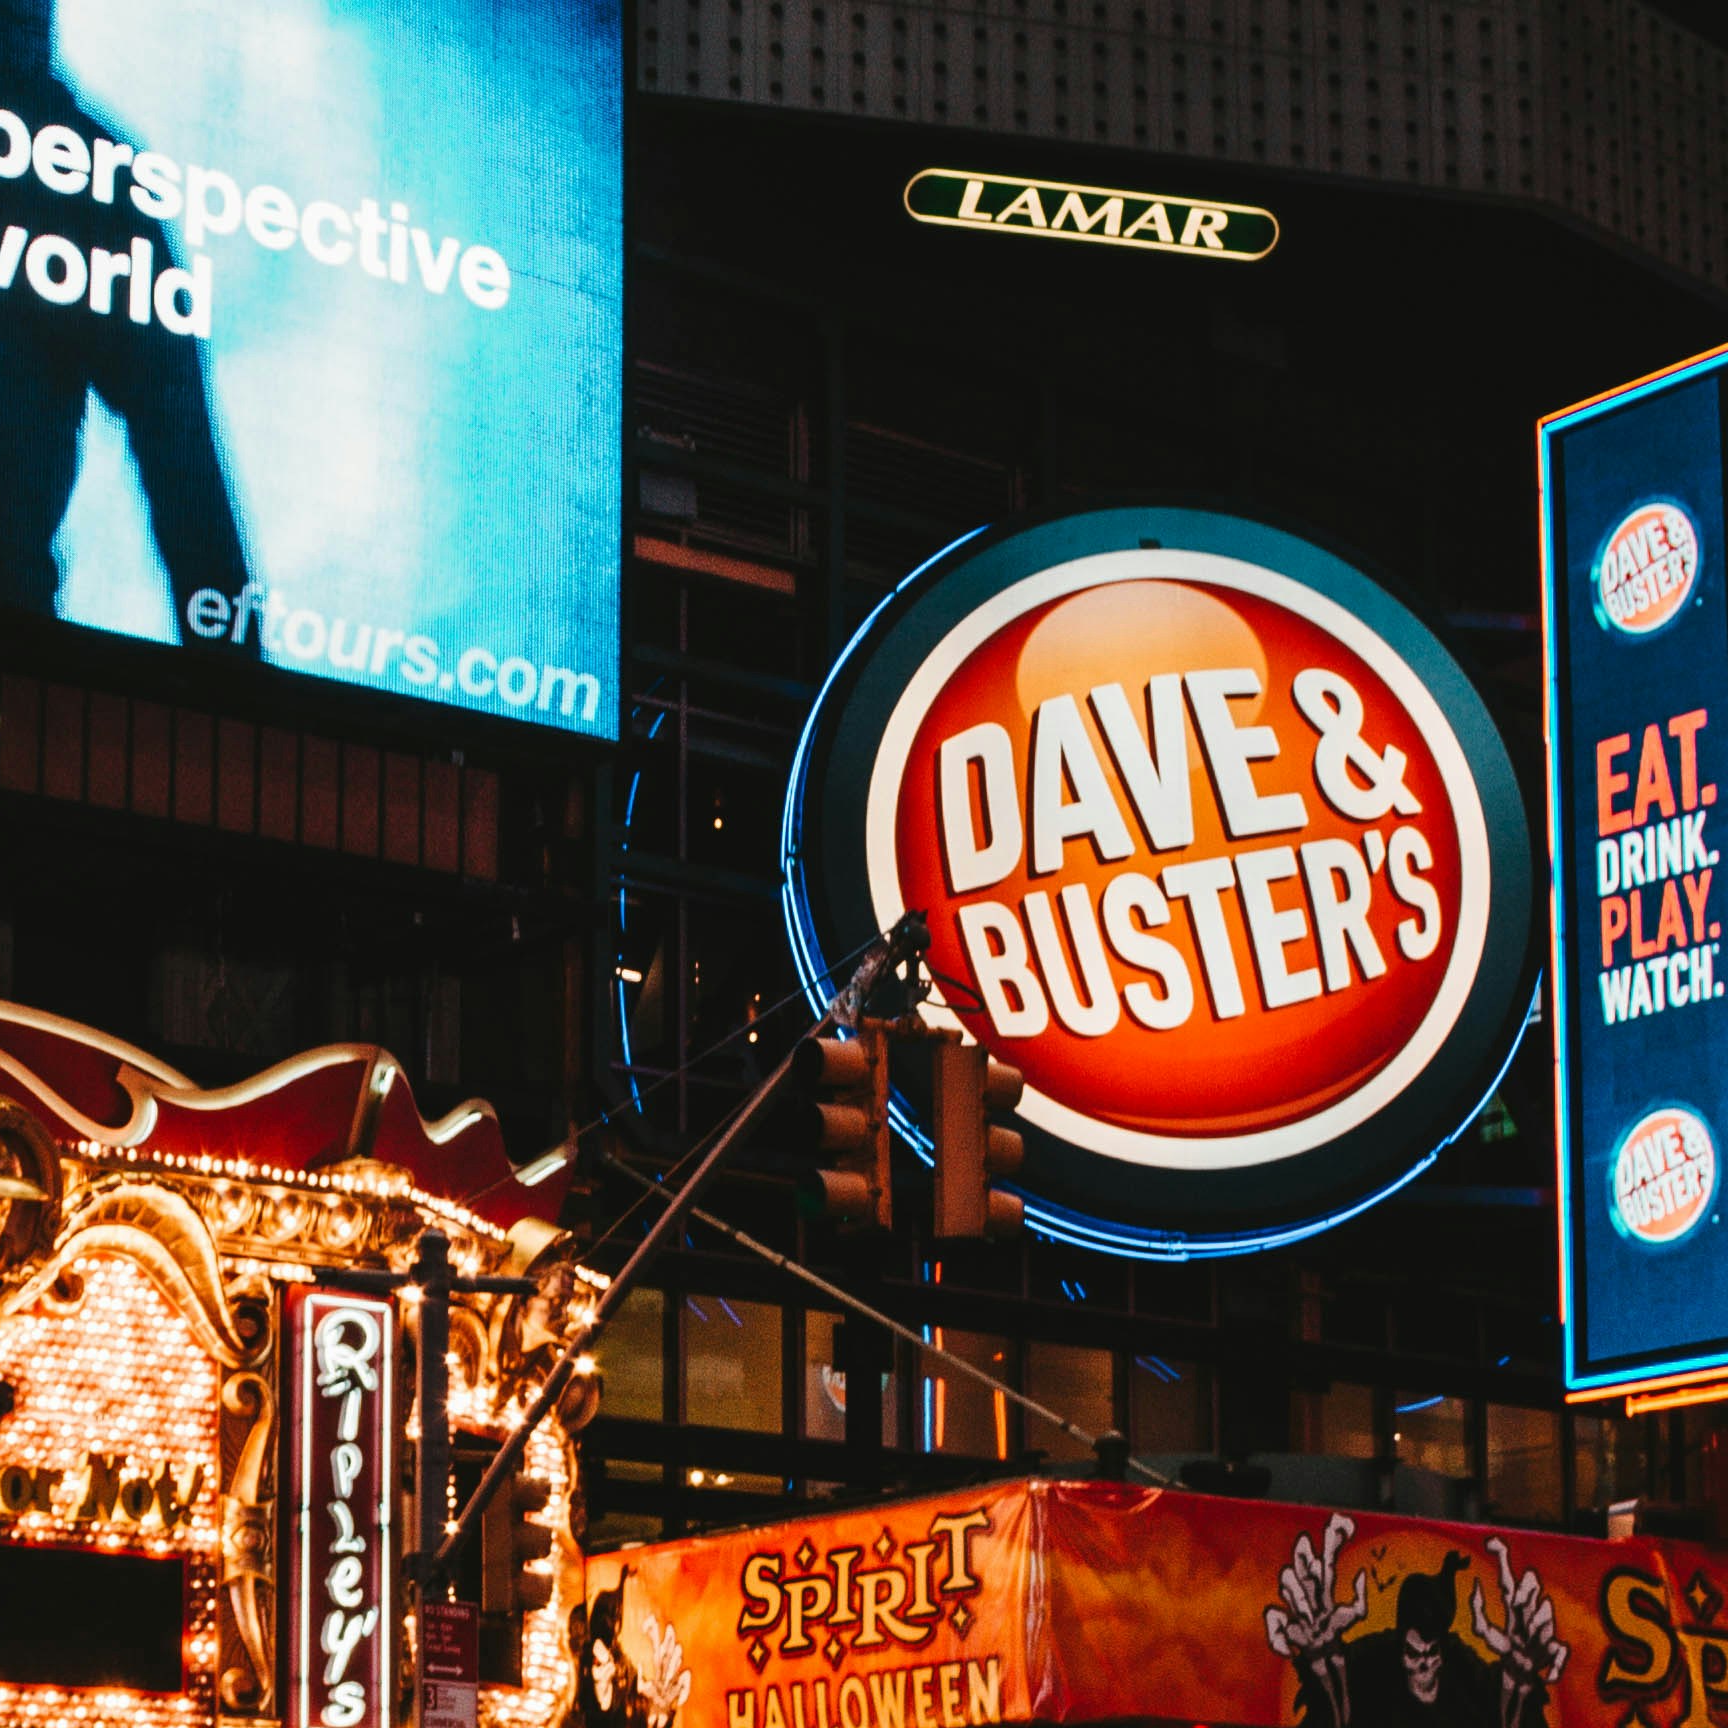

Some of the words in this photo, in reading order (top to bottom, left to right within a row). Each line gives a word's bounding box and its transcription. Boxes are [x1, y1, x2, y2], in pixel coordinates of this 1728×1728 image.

[957, 179, 1230, 250] LAMAR
[1602, 518, 1669, 595] DAVE
[187, 580, 600, 722] eftours.com
[940, 668, 1307, 893] DAVE
[1292, 667, 1424, 822] &
[1595, 710, 1717, 836] EAT.
[1597, 818, 1720, 897] DRINK.
[957, 828, 1443, 1040] BUSTER'S
[1600, 872, 1722, 966] PLAY.
[1600, 942, 1726, 1025] WATCH.
[1617, 1125, 1686, 1195] DAVE
[64, 1453, 205, 1528] Not!
[312, 1307, 382, 1727] Ripley's
[739, 1508, 993, 1655] SPIRIT
